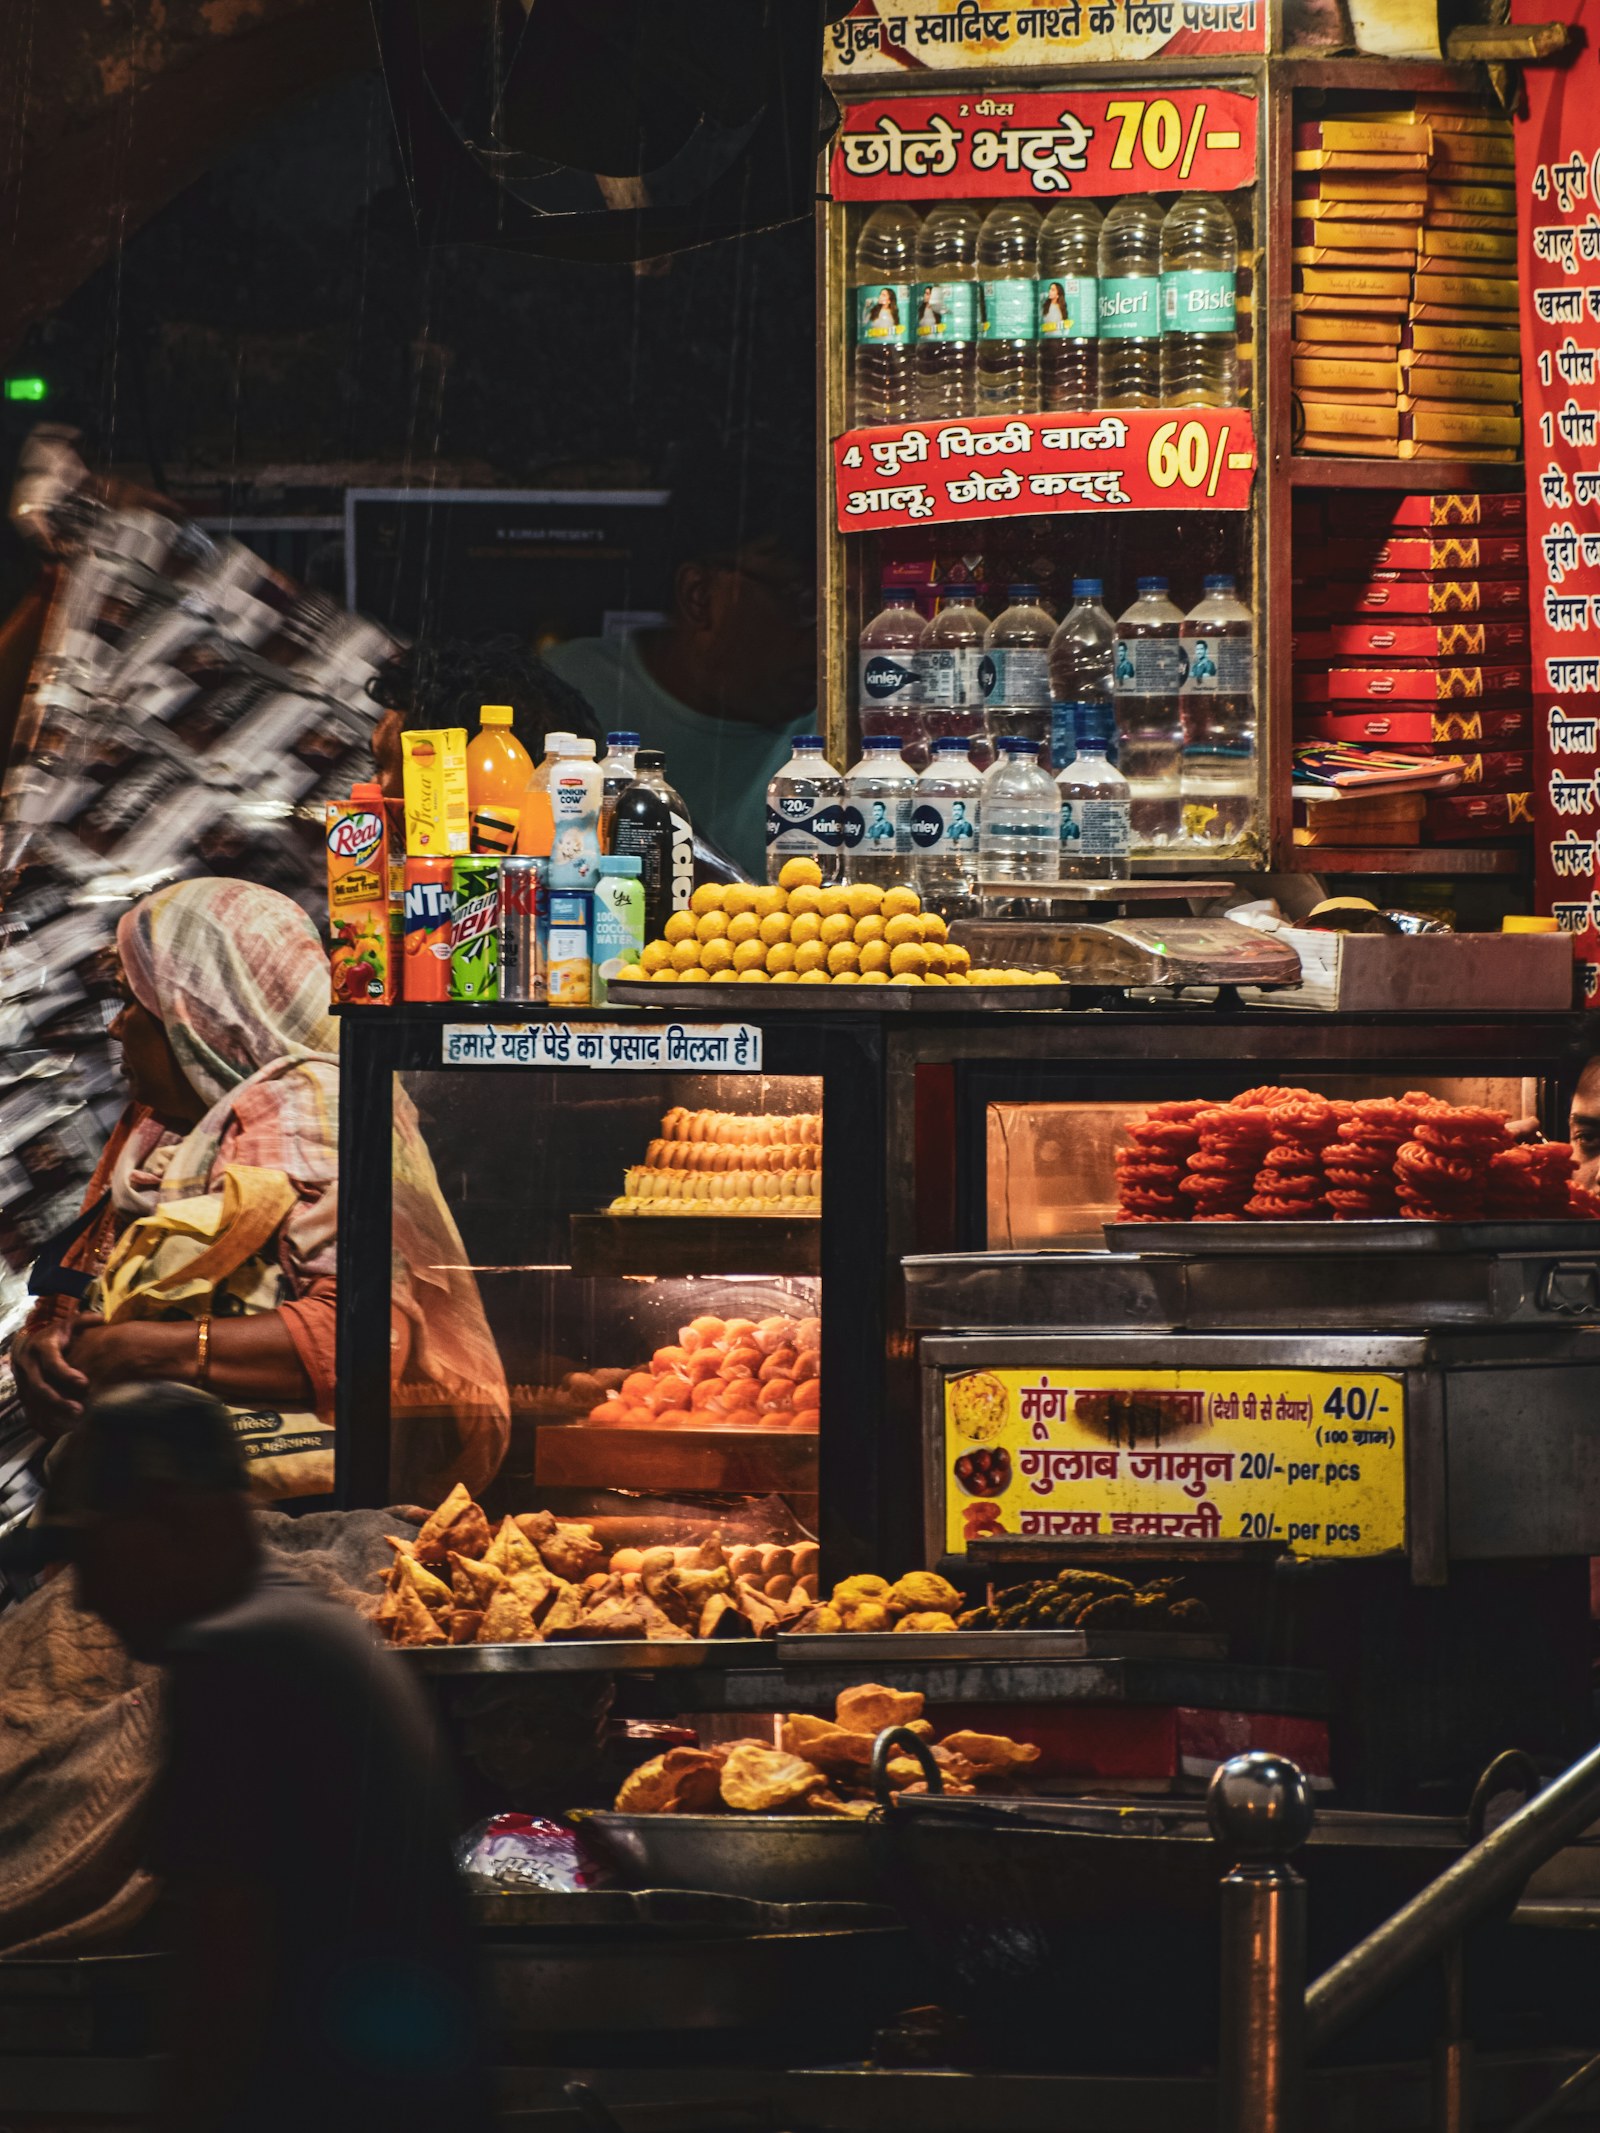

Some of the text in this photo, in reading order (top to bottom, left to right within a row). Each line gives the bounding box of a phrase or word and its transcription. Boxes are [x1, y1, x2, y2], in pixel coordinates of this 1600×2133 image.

[832, 17, 881, 66] शुद्ध
[888, 16, 909, 46] व
[909, 4, 1011, 45] स्वादिष्ट
[1016, 1, 1083, 39] नाश्ते
[1089, 0, 1117, 36] के
[1125, 0, 1175, 35] लिए
[959, 99, 1014, 117] 2 पीस
[842, 99, 1241, 190] छोले भटूरे 70/-
[1535, 167, 1548, 199] 4
[1555, 152, 1587, 211] पूरी
[1536, 226, 1574, 270] आलू
[1536, 289, 1583, 322] खस्ता
[1539, 338, 1594, 382] 1 पीस
[1541, 402, 1597, 445] 1 पीस
[843, 446, 863, 469] 4
[871, 432, 930, 476] पुरी
[1040, 417, 1130, 451] वाली
[1147, 420, 1254, 497] 60/-
[844, 484, 936, 519] आलू,
[946, 468, 1025, 504] छोले
[866, 670, 903, 687] kinley
[1550, 706, 1596, 753] पिस्ता
[560, 796, 582, 805] COW
[335, 814, 379, 860] Real
[449, 1023, 497, 1061] हमारे
[577, 1034, 604, 1060] का
[610, 1035, 662, 1064] प्रसाद
[667, 1024, 729, 1062] मिलता
[1020, 1376, 1068, 1440] मूंग
[1242, 1391, 1257, 1421] घी
[1260, 1393, 1273, 1421] से
[1322, 1386, 1389, 1421] 40/-
[1316, 1425, 1348, 1449] (100
[1019, 1449, 1361, 1499] गुलाब जामुन 20/- per pcs
[1240, 1513, 1283, 1538] 20/-
[1288, 1522, 1320, 1545] per
[1325, 1522, 1361, 1547] pcs
